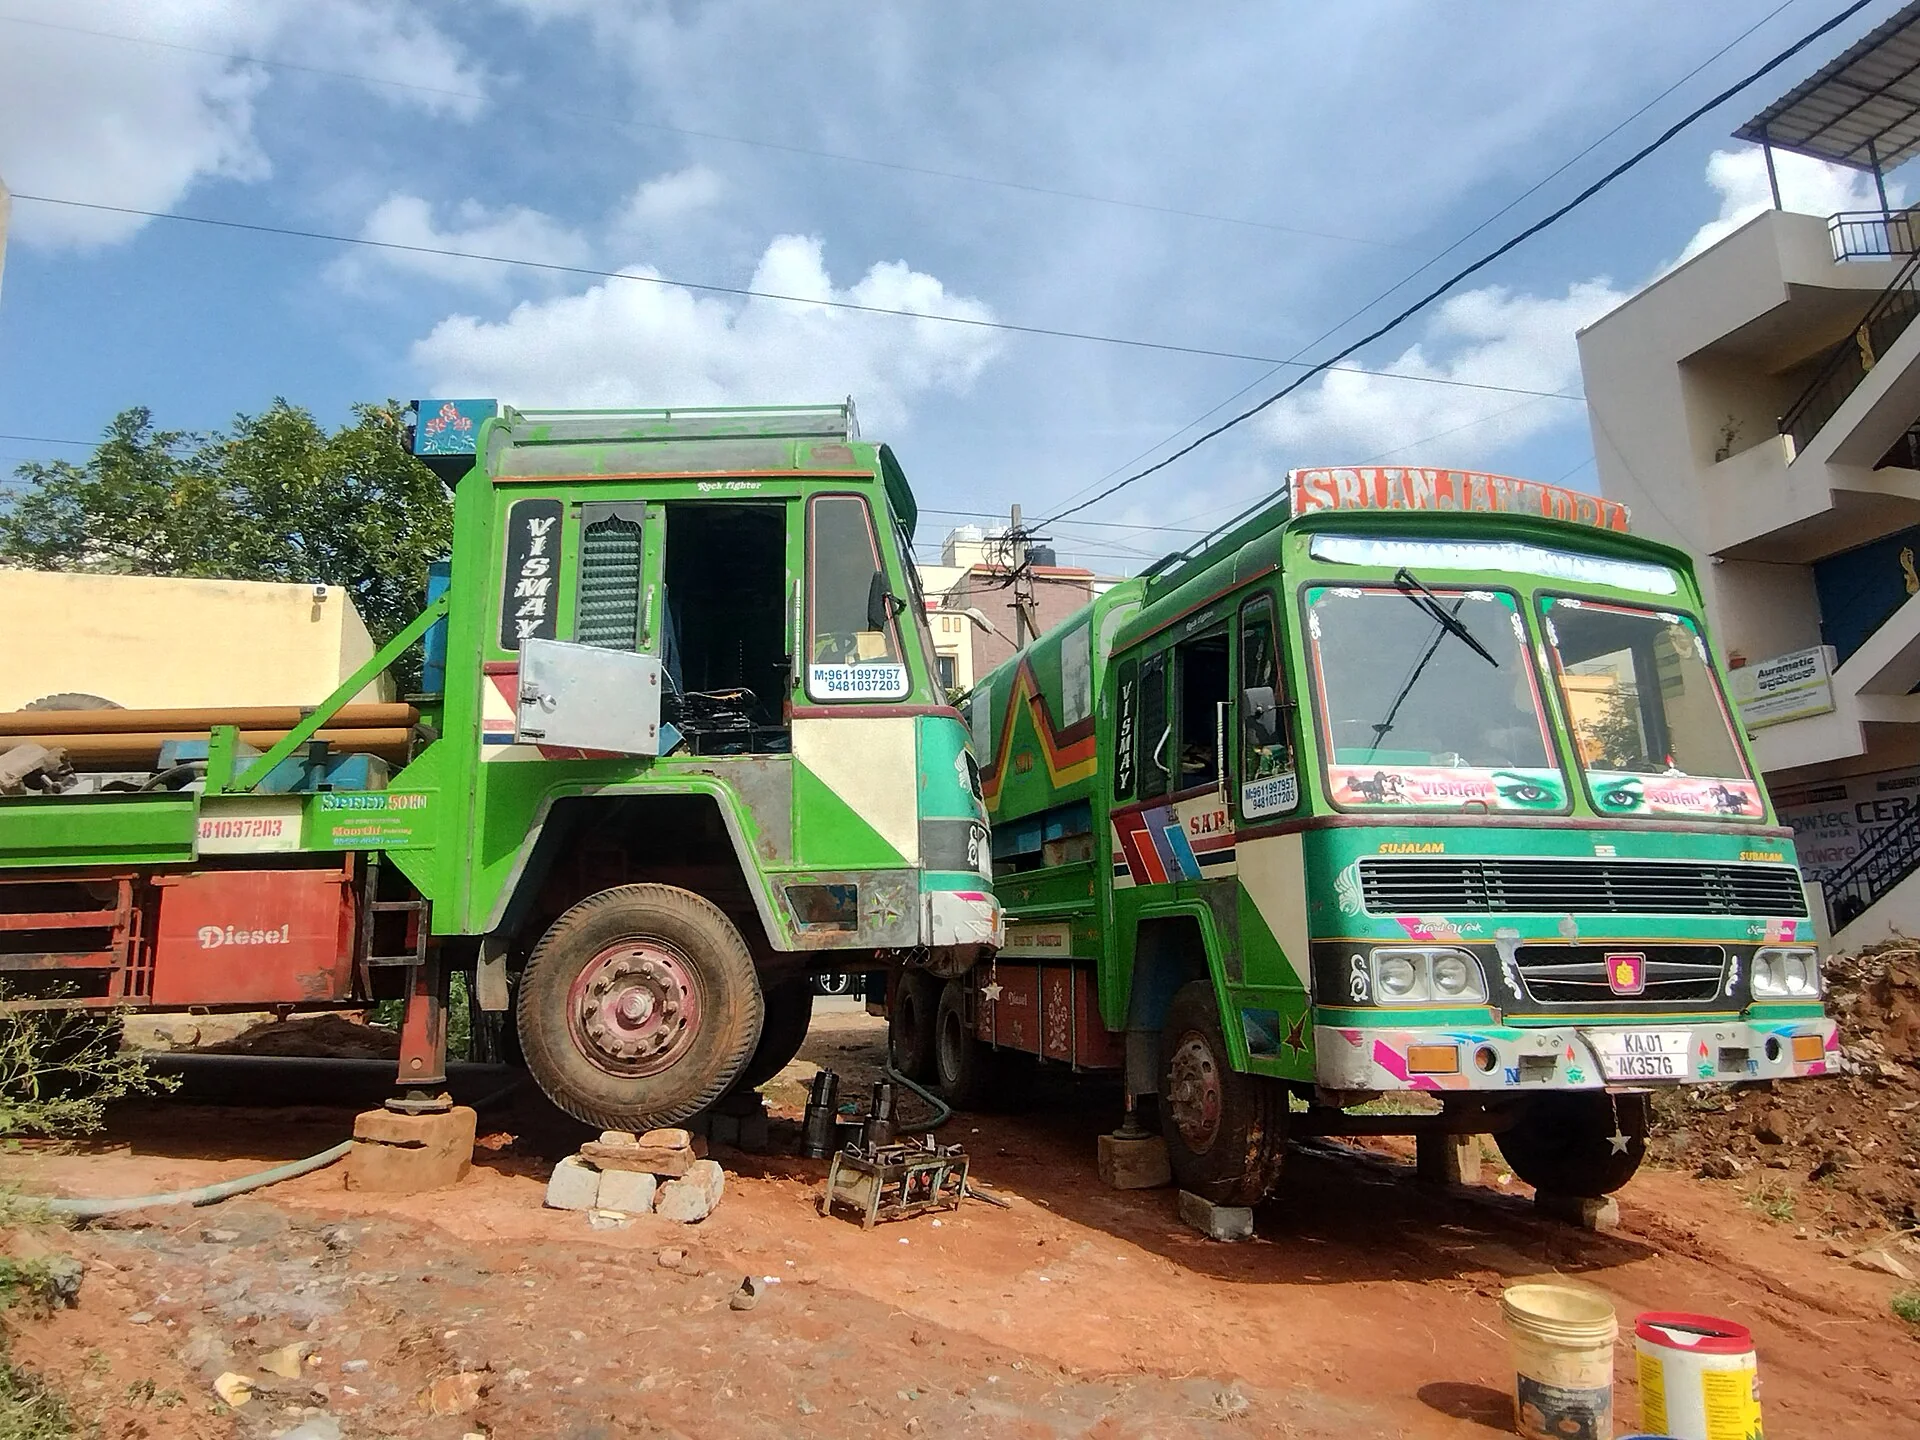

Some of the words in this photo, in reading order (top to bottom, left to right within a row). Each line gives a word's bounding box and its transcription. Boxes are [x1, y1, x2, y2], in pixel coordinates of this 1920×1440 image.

[697, 482, 723, 492] Rock
[725, 481, 762, 491] fighter
[513, 516, 557, 638] VISMAY
[828, 680, 900, 692] 9481037203
[1119, 681, 1132, 789] VISMAY
[1252, 790, 1295, 810] 9481037203
[1421, 782, 1487, 798] VISMAY
[1855, 796, 1920, 824] CER
[1379, 842, 1445, 855] SUJALAM
[198, 923, 290, 949] Diesel
[1412, 922, 1445, 934] Hard
[1446, 922, 1484, 934] Work
[1619, 1056, 1673, 1076] AK3576
